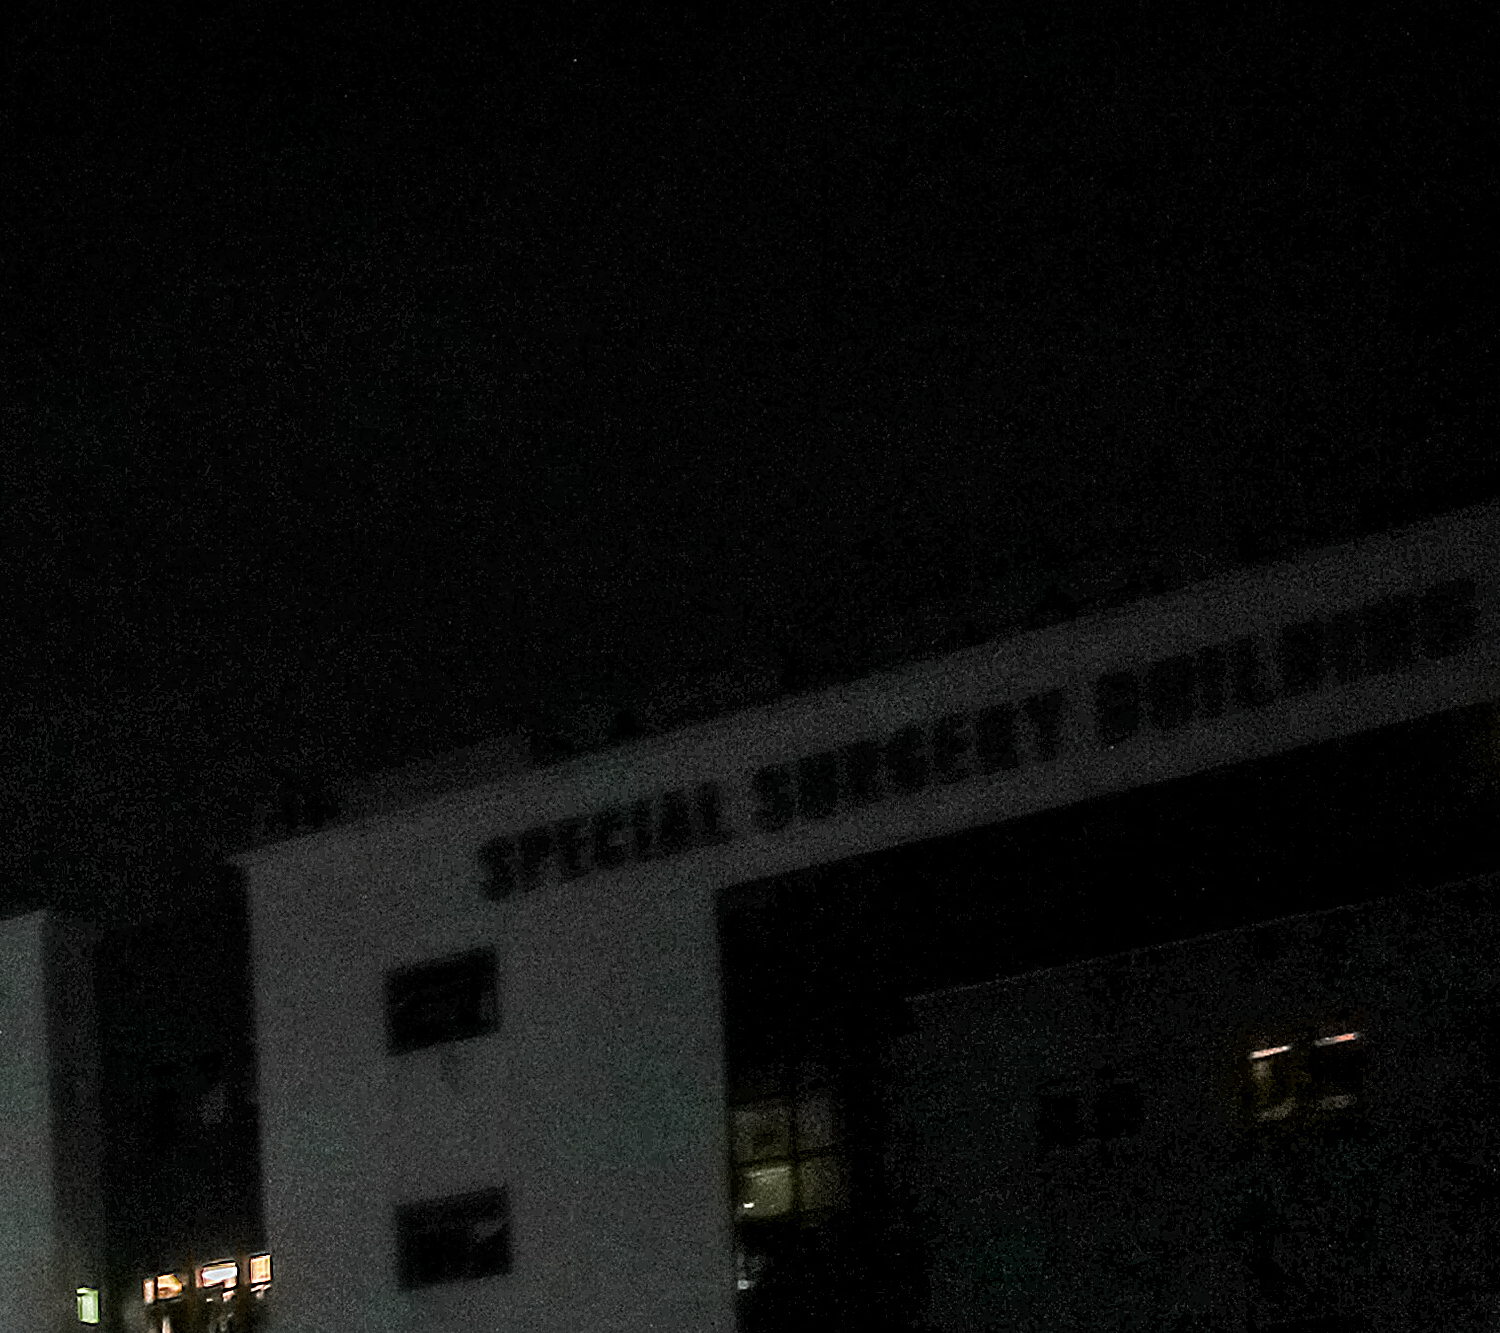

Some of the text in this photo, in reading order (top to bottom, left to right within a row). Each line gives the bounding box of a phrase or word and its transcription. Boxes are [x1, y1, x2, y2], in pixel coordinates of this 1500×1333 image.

[476, 577, 1477, 902] SPECIAL SURGERY BUILDING
